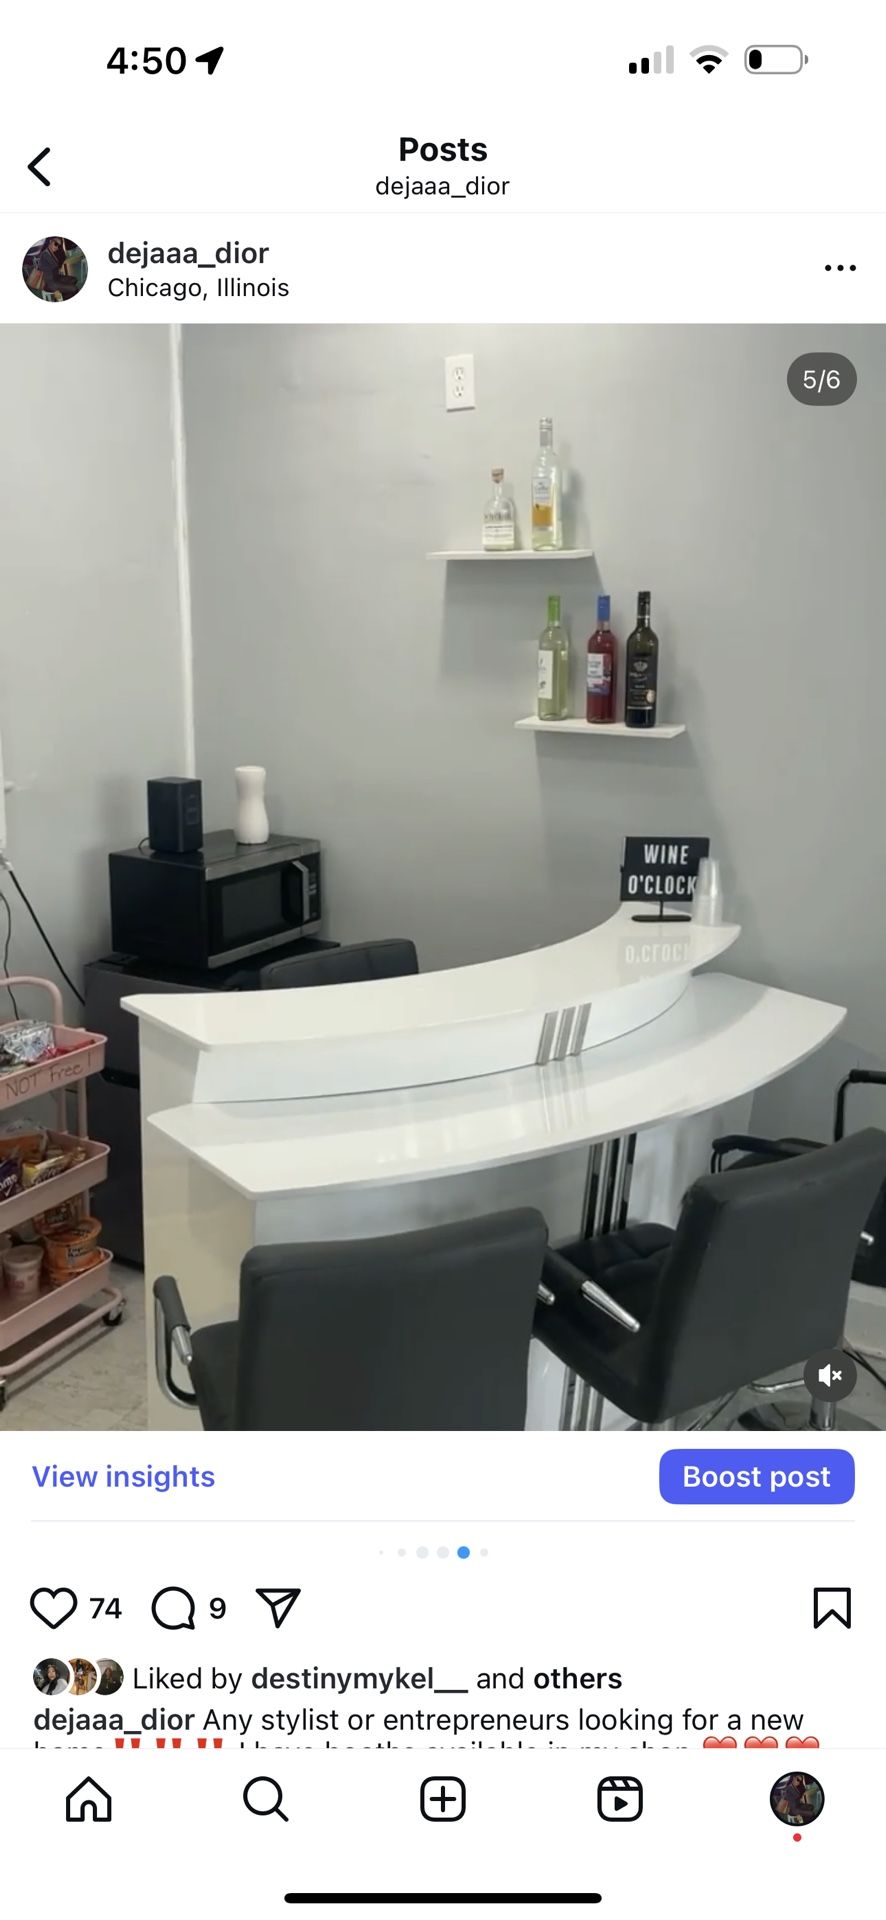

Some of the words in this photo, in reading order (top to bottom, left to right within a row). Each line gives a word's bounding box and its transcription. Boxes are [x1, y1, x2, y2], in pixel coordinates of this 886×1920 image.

[643, 843, 690, 865] WINE
[627, 874, 698, 896] O'CLOCK
[6, 1066, 43, 1101] NOT
[48, 1062, 84, 1084] Free
